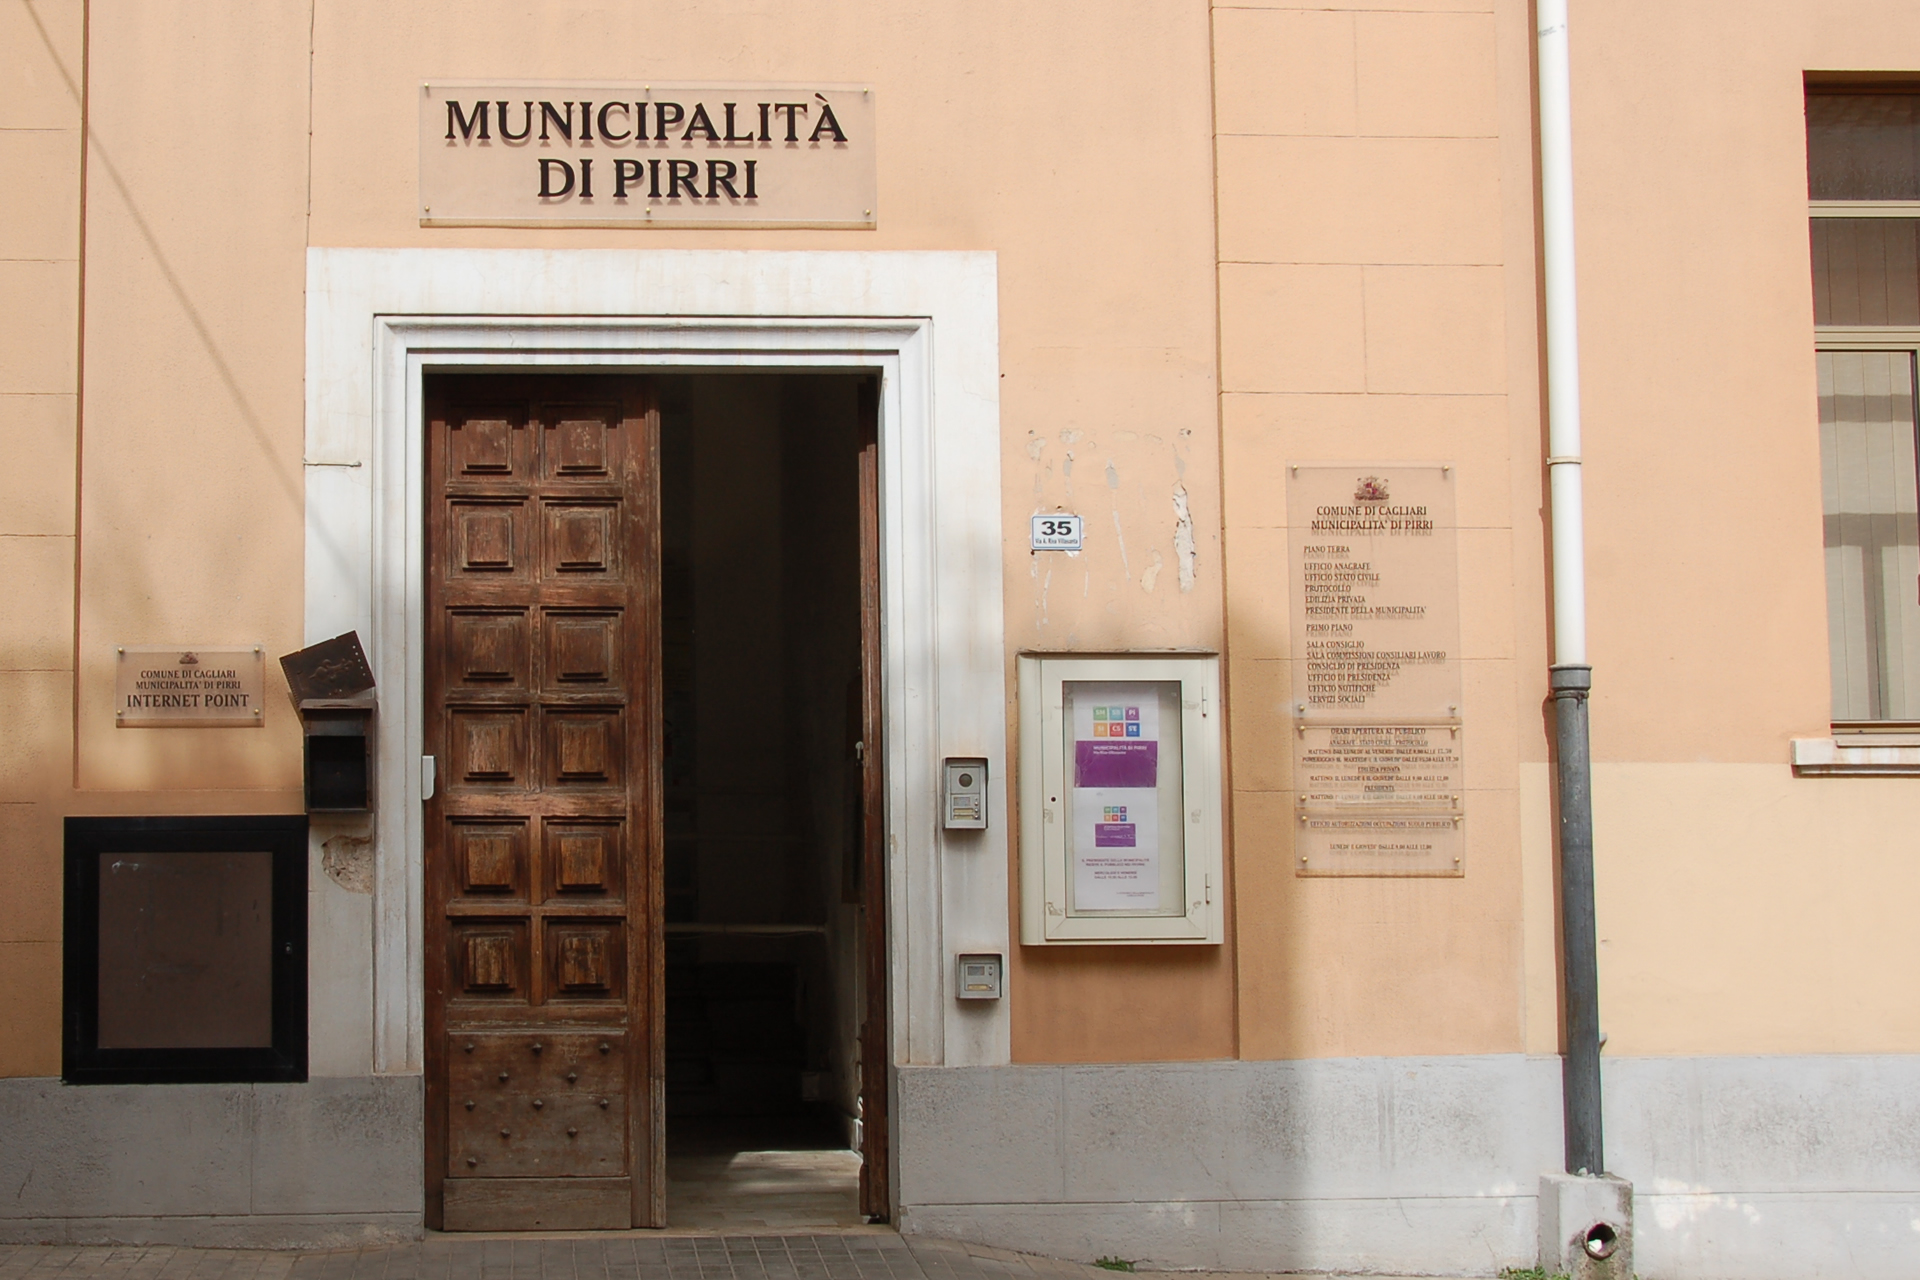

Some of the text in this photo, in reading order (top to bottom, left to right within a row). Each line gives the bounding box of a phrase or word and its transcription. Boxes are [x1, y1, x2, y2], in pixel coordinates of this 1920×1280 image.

[445, 93, 848, 142] MUNICIPALITÀ
[538, 158, 758, 199] DI PIRRI
[1317, 506, 1427, 516] COMUNE DI CAGLIARI
[1041, 521, 1072, 536] 35
[1312, 520, 1433, 530] MUNICIPALITA' DI PIRRI
[1304, 562, 1371, 570] UFFICIO ANAGRAFE
[1305, 596, 1366, 604] EDILIZIA PRIVATA
[1306, 606, 1349, 614] PRESIDENTE
[1351, 606, 1374, 614] DELLA
[1306, 624, 1353, 632] PRIMO PIANO
[1307, 641, 1365, 649] SALA CONSIGLIO
[1307, 651, 1446, 659] SALA COMMISSIONI CONSILIARI LAVORO
[1307, 662, 1400, 670] CONSIGLIO DI PRESIDENZA
[141, 670, 236, 679] COMUNE DI CAGLIARI
[1308, 674, 1391, 682] UFFICIO DI PRESIDENZA
[136, 681, 241, 690] MUNICIPALITA' DI PIRRI
[127, 695, 250, 707] INTERNET POINT
[1309, 696, 1366, 704] SERVIZI SOCIALI
